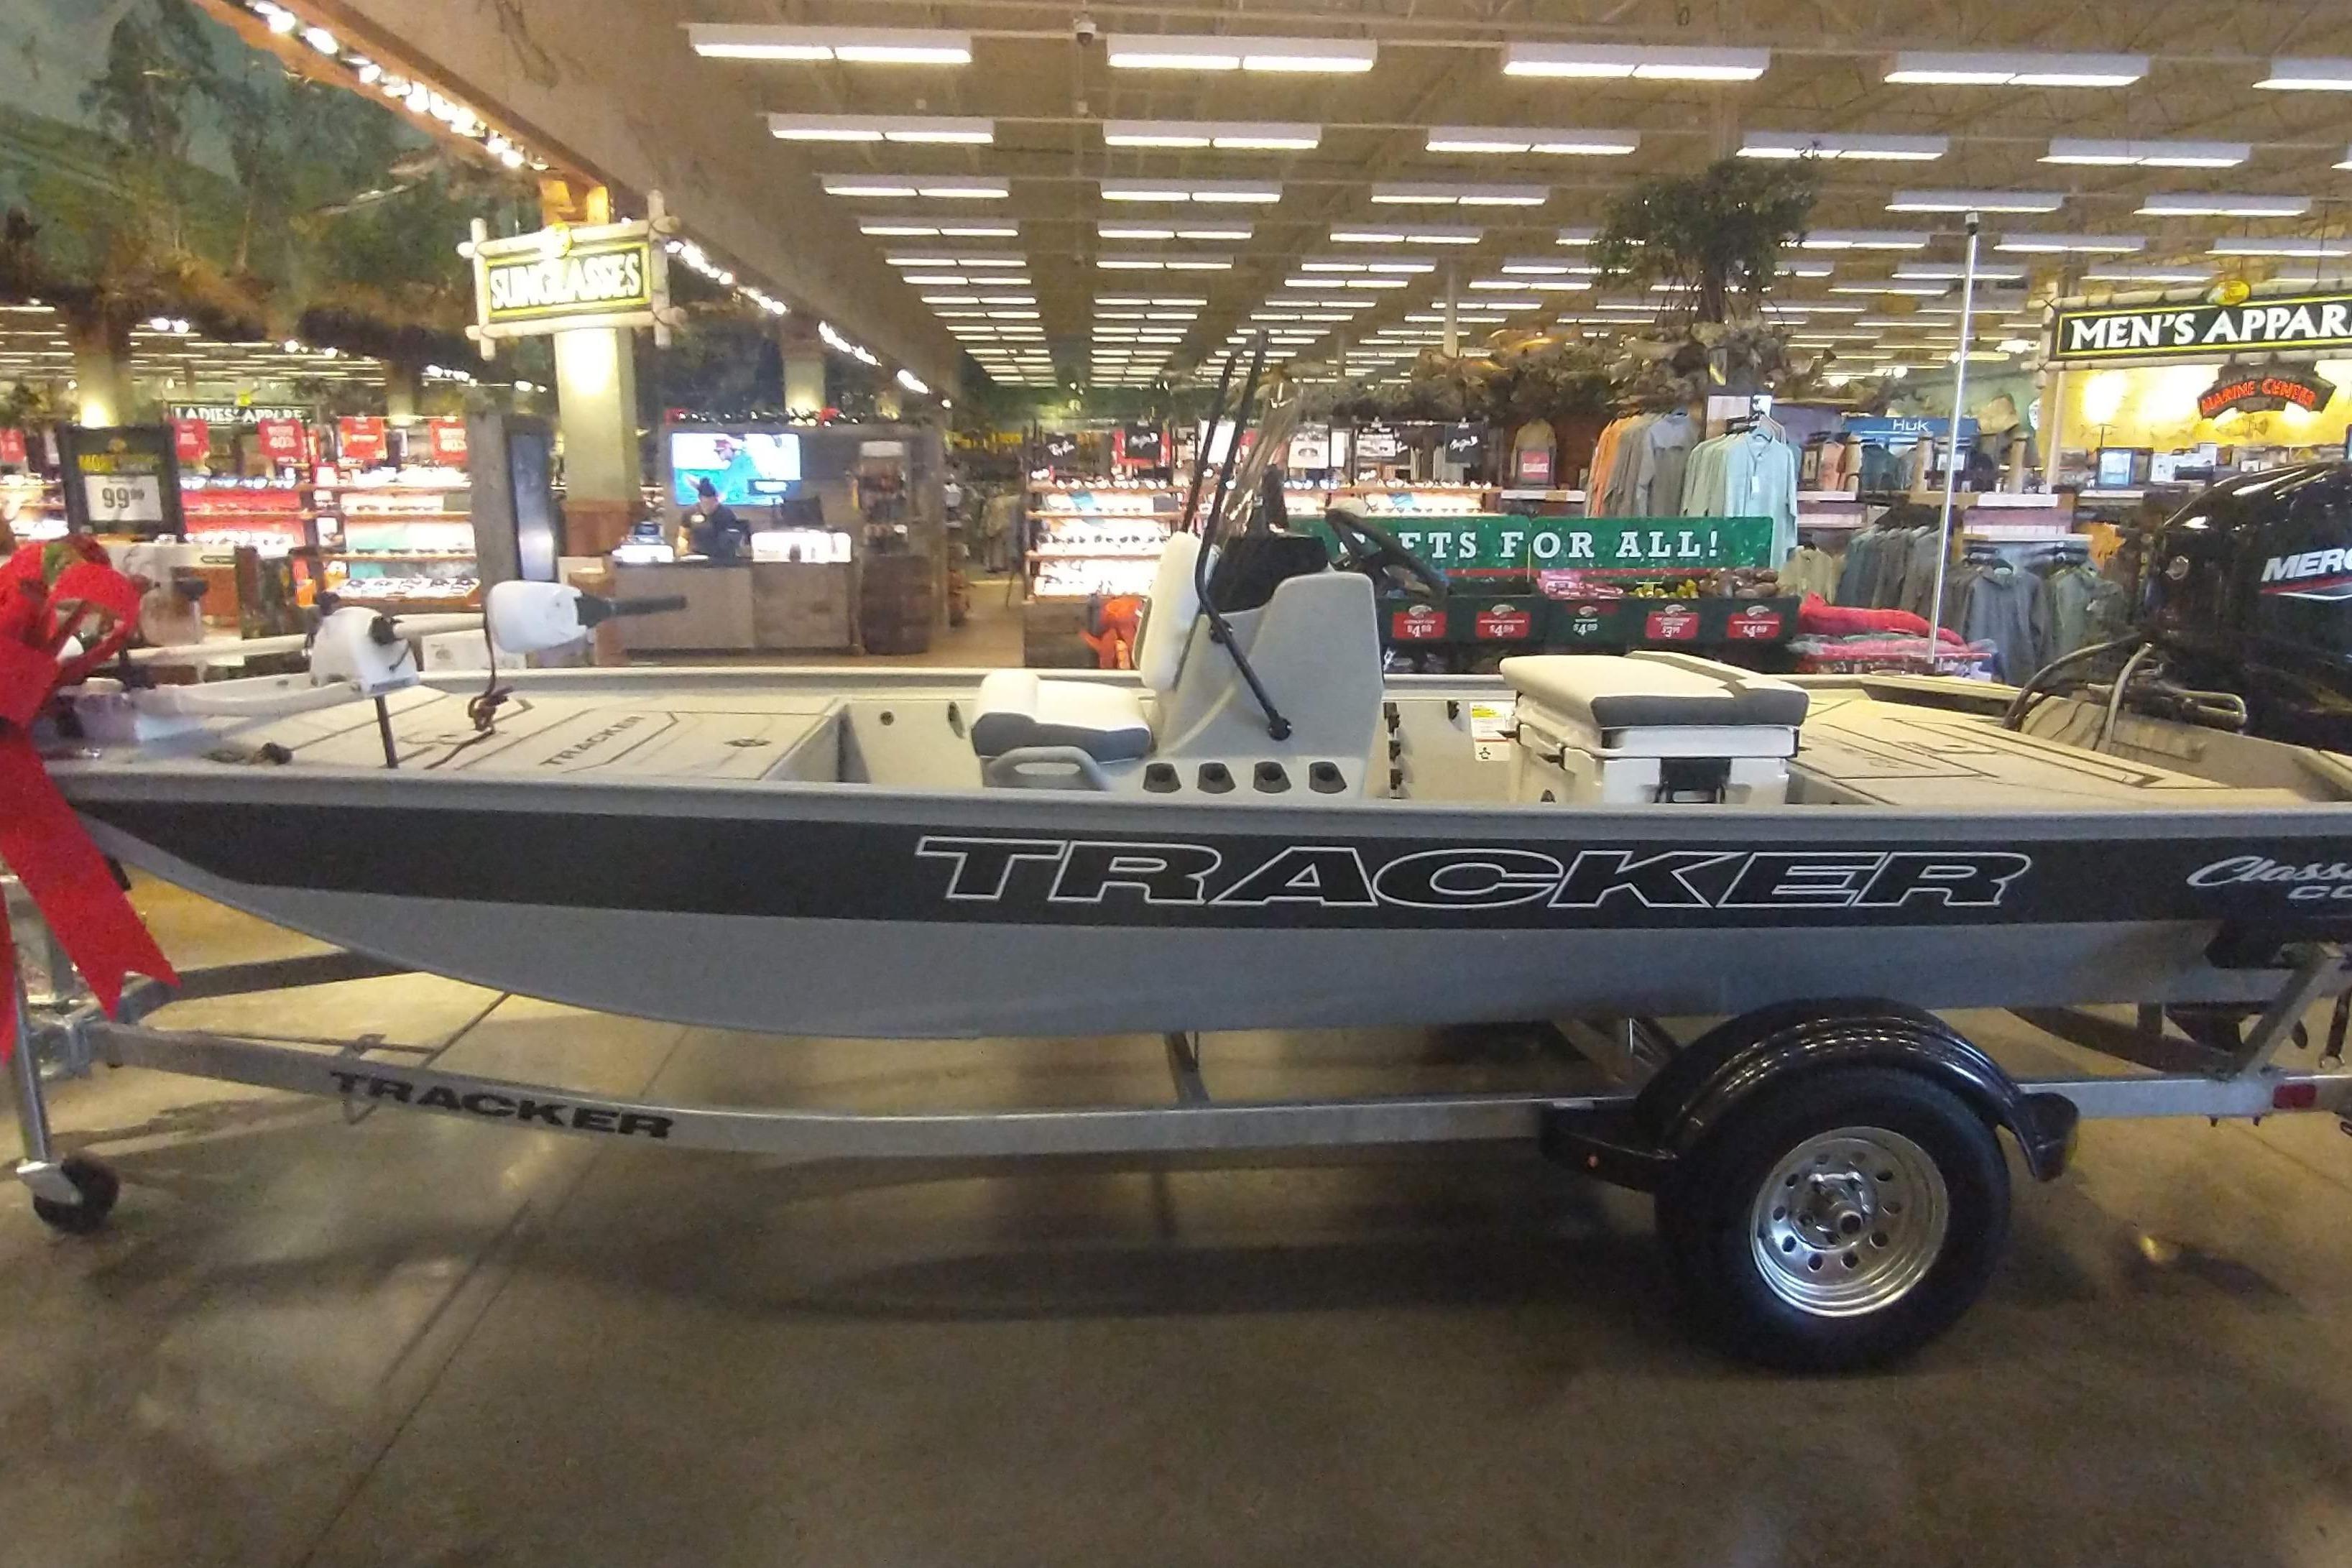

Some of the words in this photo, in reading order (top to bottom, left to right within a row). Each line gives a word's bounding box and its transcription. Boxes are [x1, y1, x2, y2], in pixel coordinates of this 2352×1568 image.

[2070, 312, 2196, 350] MEN'S
[2201, 303, 2352, 343] APPAR
[243, 408, 312, 423] APPARE
[1500, 532, 1595, 559] FOR
[1615, 531, 1718, 558] ALL!
[914, 835, 2032, 909] TRACKER
[329, 1070, 675, 1139] TRACKER
